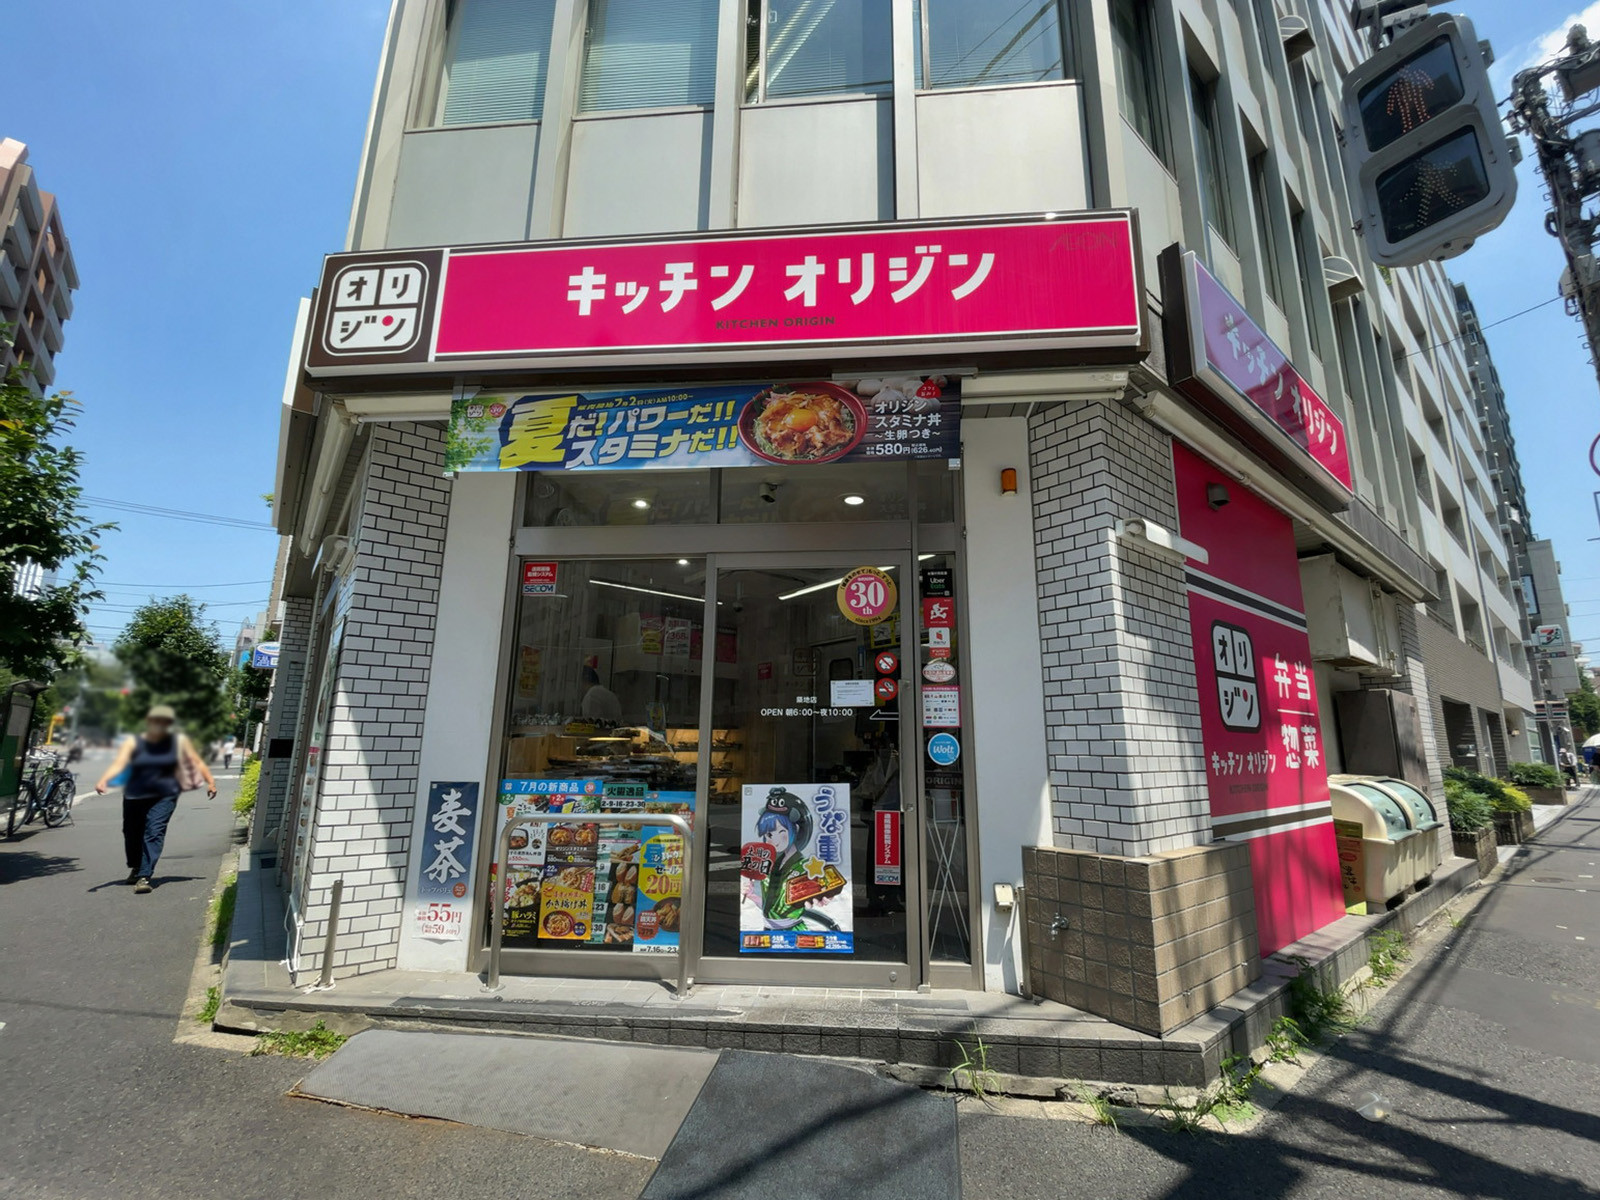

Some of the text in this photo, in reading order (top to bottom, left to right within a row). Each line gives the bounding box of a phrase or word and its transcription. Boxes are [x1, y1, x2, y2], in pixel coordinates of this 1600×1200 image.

[346, 273, 410, 301] オリ
[567, 245, 995, 317] キッチン オリジン
[339, 314, 407, 343] ジン
[716, 316, 836, 330] KITCHEN ORIGIN
[1224, 312, 1337, 455] キッチン オリジン
[875, 400, 927, 414] オリジン
[875, 412, 942, 429] スタミナ丼
[499, 396, 578, 470] 夏
[875, 442, 911, 455] 580円
[524, 585, 554, 593] SECOM
[850, 581, 885, 608] 30
[862, 606, 873, 615] th
[1273, 652, 1312, 700] 弁当
[760, 708, 783, 717] OPEN
[933, 745, 955, 754] Wolt
[1281, 722, 1319, 769] 惣菜
[1211, 748, 1277, 777] キッチン オリジン
[520, 781, 579, 793] 7月の新商品
[423, 788, 472, 884] 麦茶
[815, 788, 845, 863] うな重
[655, 865, 679, 875] セール
[645, 874, 680, 895] 20円
[427, 903, 462, 923] 55円
